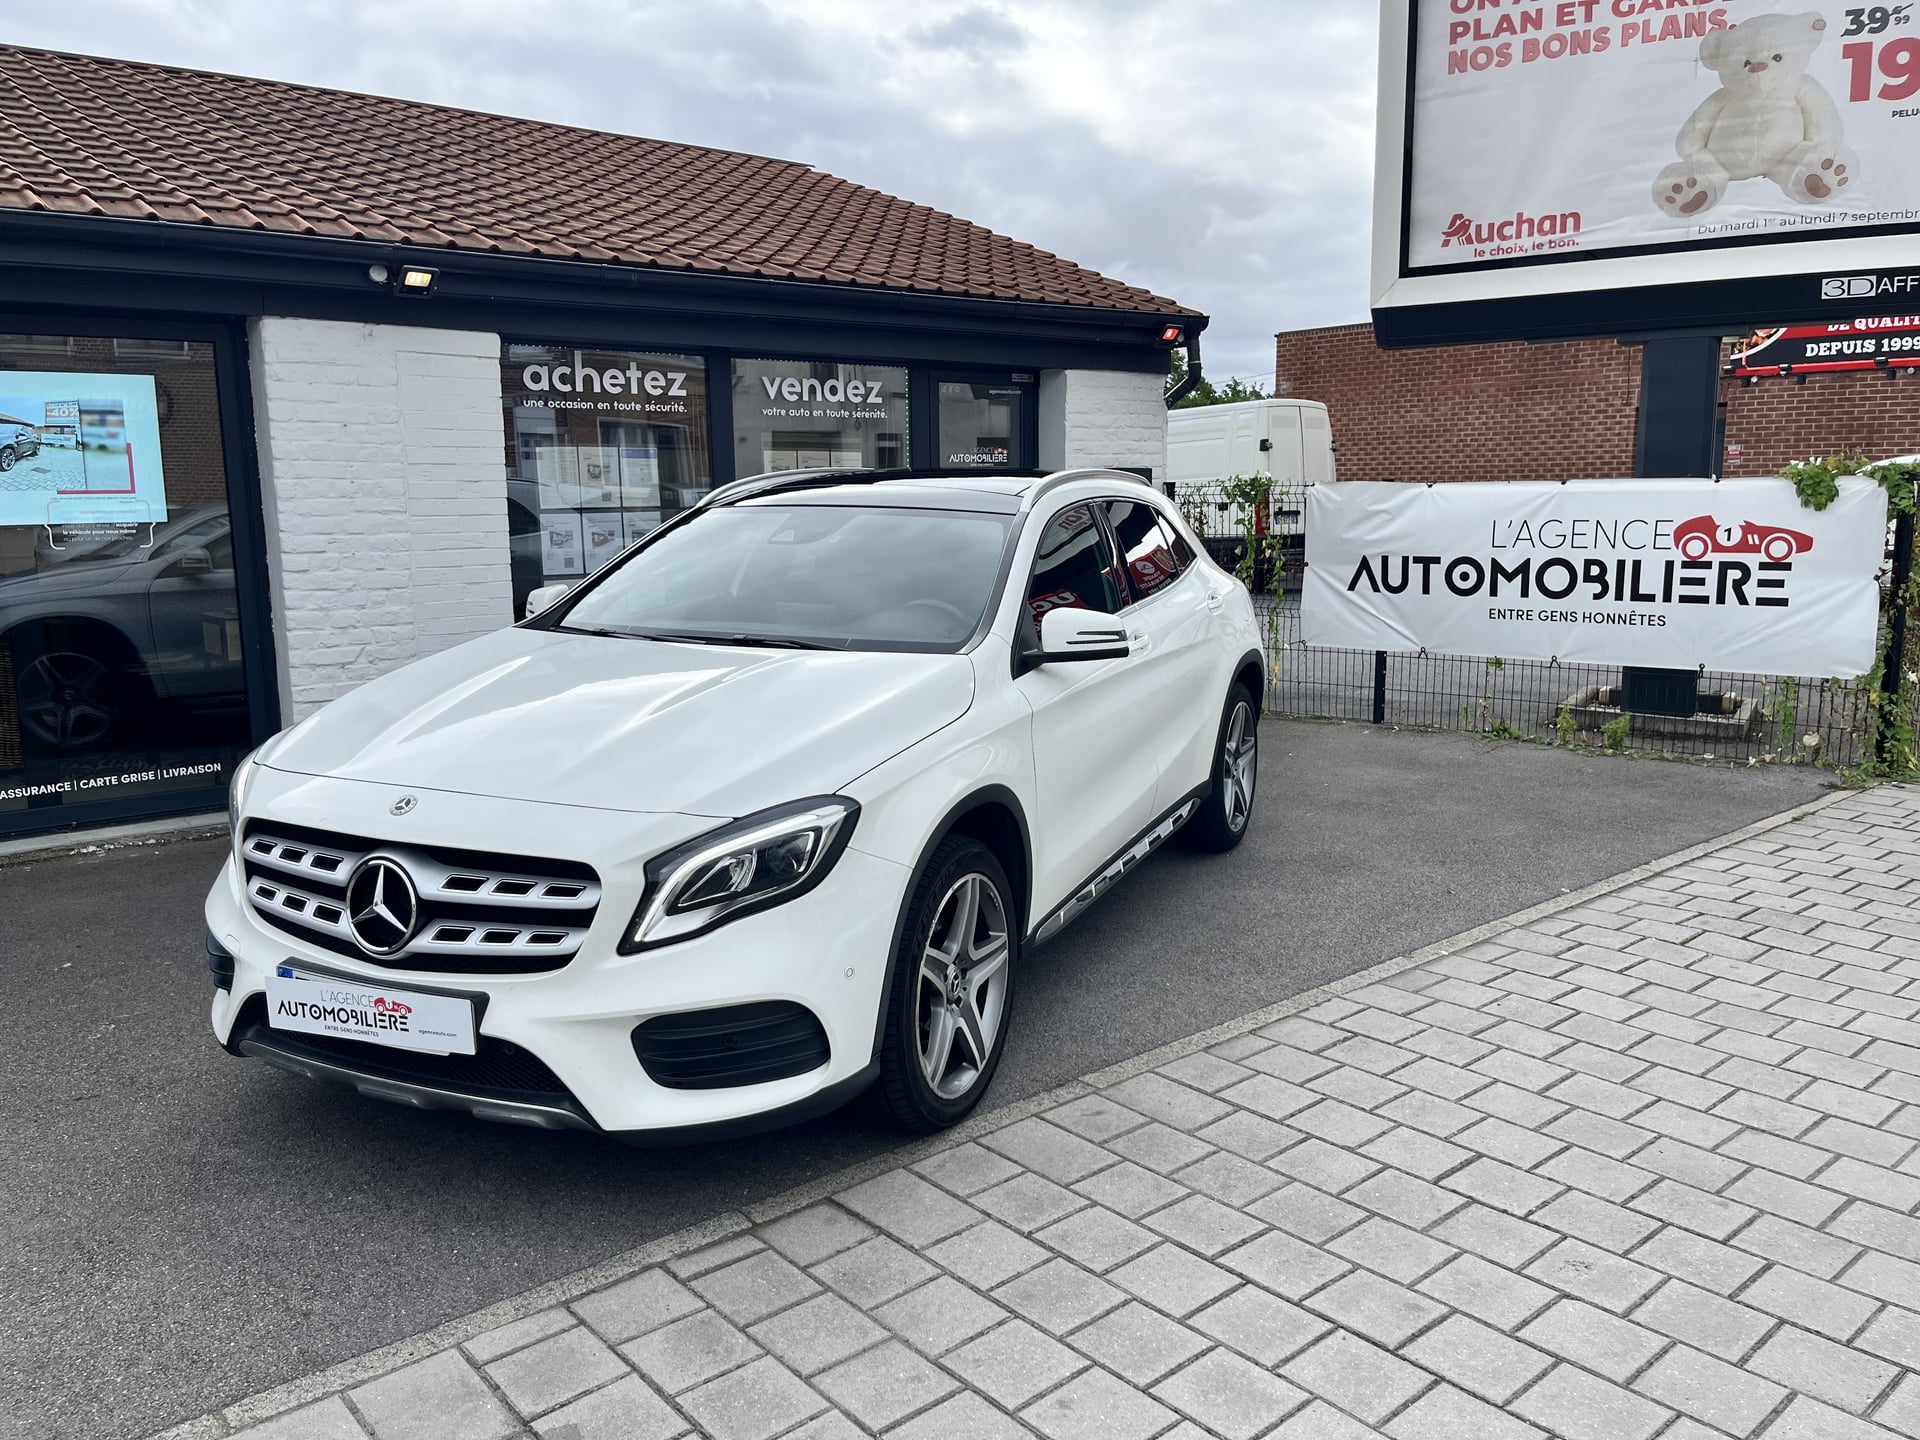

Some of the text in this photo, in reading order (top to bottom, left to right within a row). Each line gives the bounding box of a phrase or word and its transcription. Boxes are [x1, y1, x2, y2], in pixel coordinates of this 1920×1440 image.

[1449, 8, 1543, 45] PLAN
[1556, 0, 1601, 27] ET
[1448, 42, 1513, 75] NOS
[1522, 26, 1611, 63] BONS
[1892, 108, 1920, 118] PELU
[1441, 211, 1581, 248] Auchan
[1697, 225, 1716, 235] Du
[1720, 218, 1759, 232] mardi
[1779, 216, 1796, 227] au
[1800, 213, 1836, 225] lundi
[1840, 212, 1848, 222] 7
[1474, 238, 1580, 258] le choix, le bon.
[1805, 336, 1920, 357] DEPUIS 1999
[523, 351, 687, 397] achetez
[761, 364, 883, 404] vendez
[523, 398, 688, 413] une occasion en toute sécurité.
[762, 407, 786, 416] votre
[789, 408, 810, 417] auto
[826, 409, 850, 418] toute
[852, 408, 888, 419] sérénité.
[1491, 519, 1674, 550] L'AGENCE
[1723, 527, 1732, 542] 1
[1489, 608, 1667, 627] ENTRE GENS HONNÊTES
[0, 762, 222, 800] ASSURANCE CARTE GRISE LIVRAISON
[320, 989, 375, 1008] L'AGENCE
